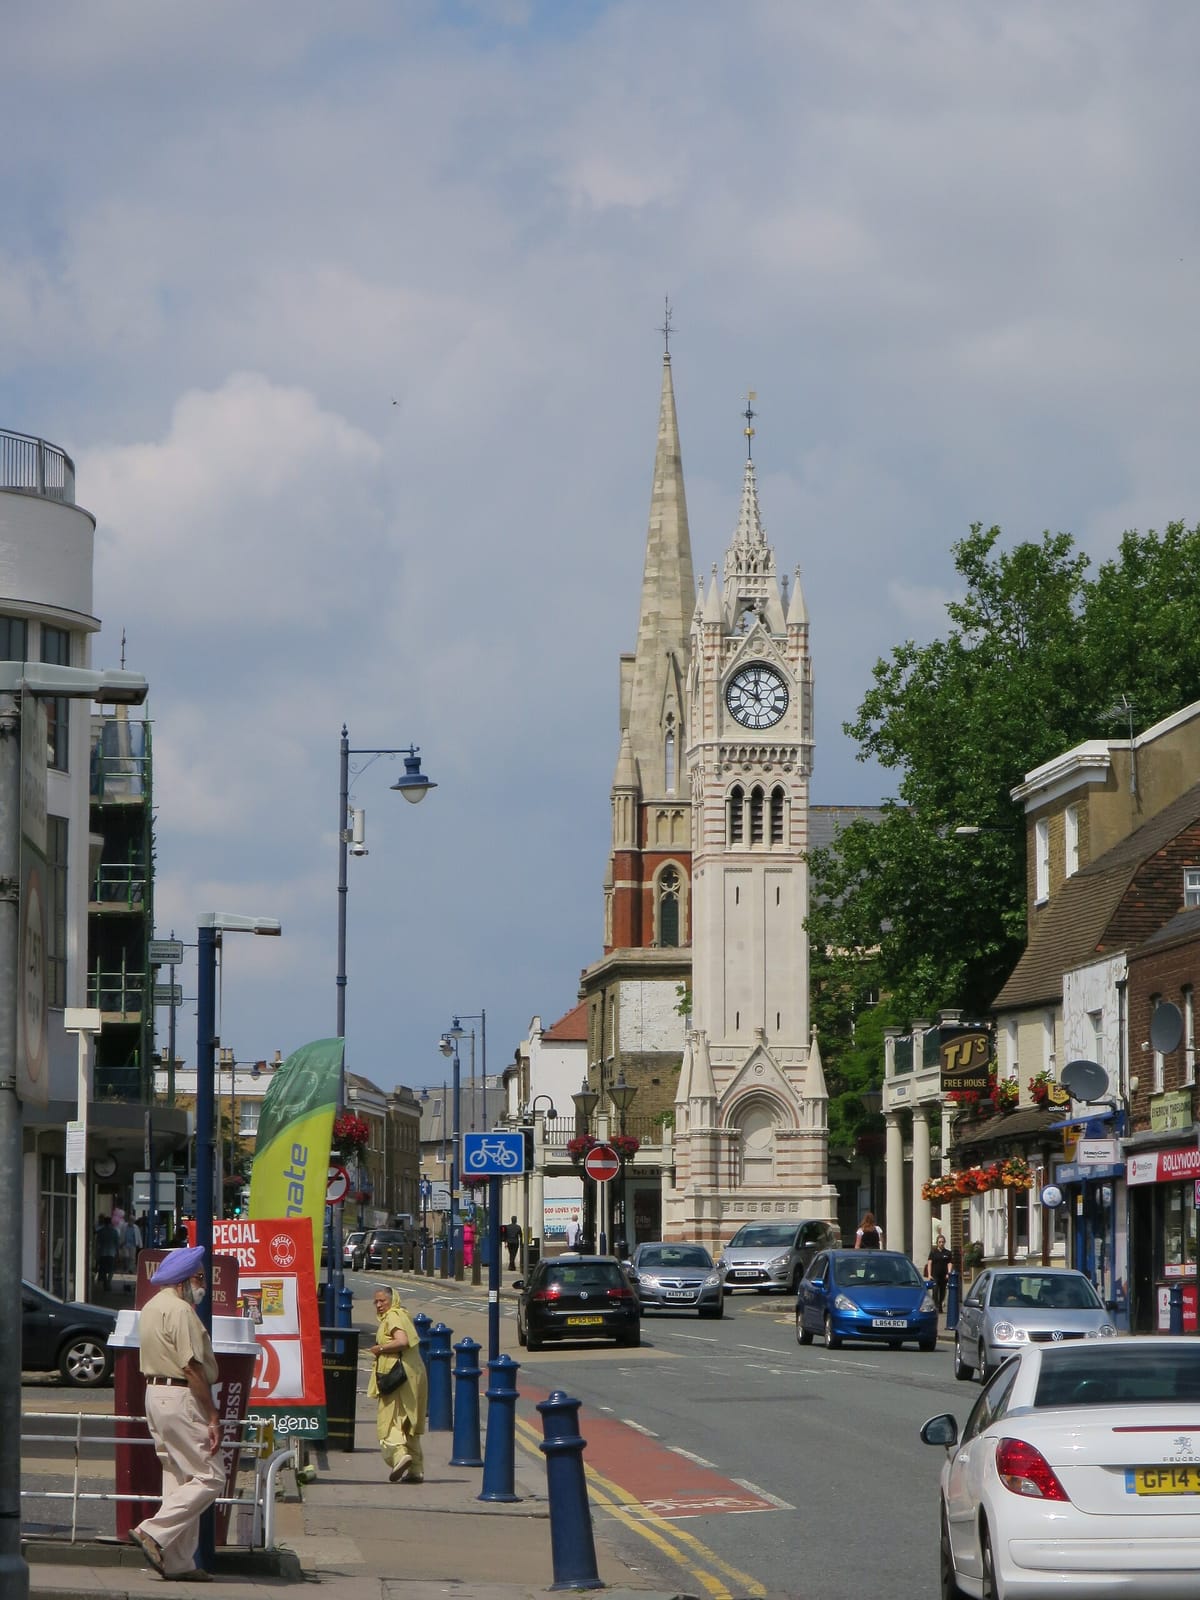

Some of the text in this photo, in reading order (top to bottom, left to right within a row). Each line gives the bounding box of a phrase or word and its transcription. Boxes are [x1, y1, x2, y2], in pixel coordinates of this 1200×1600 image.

[944, 1038, 986, 1070] TJ'S
[944, 1079, 987, 1088] FREE HOUSE
[1163, 1151, 1200, 1171] BOLLYWOOD
[212, 1224, 260, 1244] PECIAL
[272, 1236, 292, 1247] SPECIAL
[273, 1255, 293, 1265] OFFERS
[221, 1382, 242, 1474] EXPRESS
[248, 1414, 319, 1433] Bdgens
[1143, 1469, 1189, 1488] GF14
